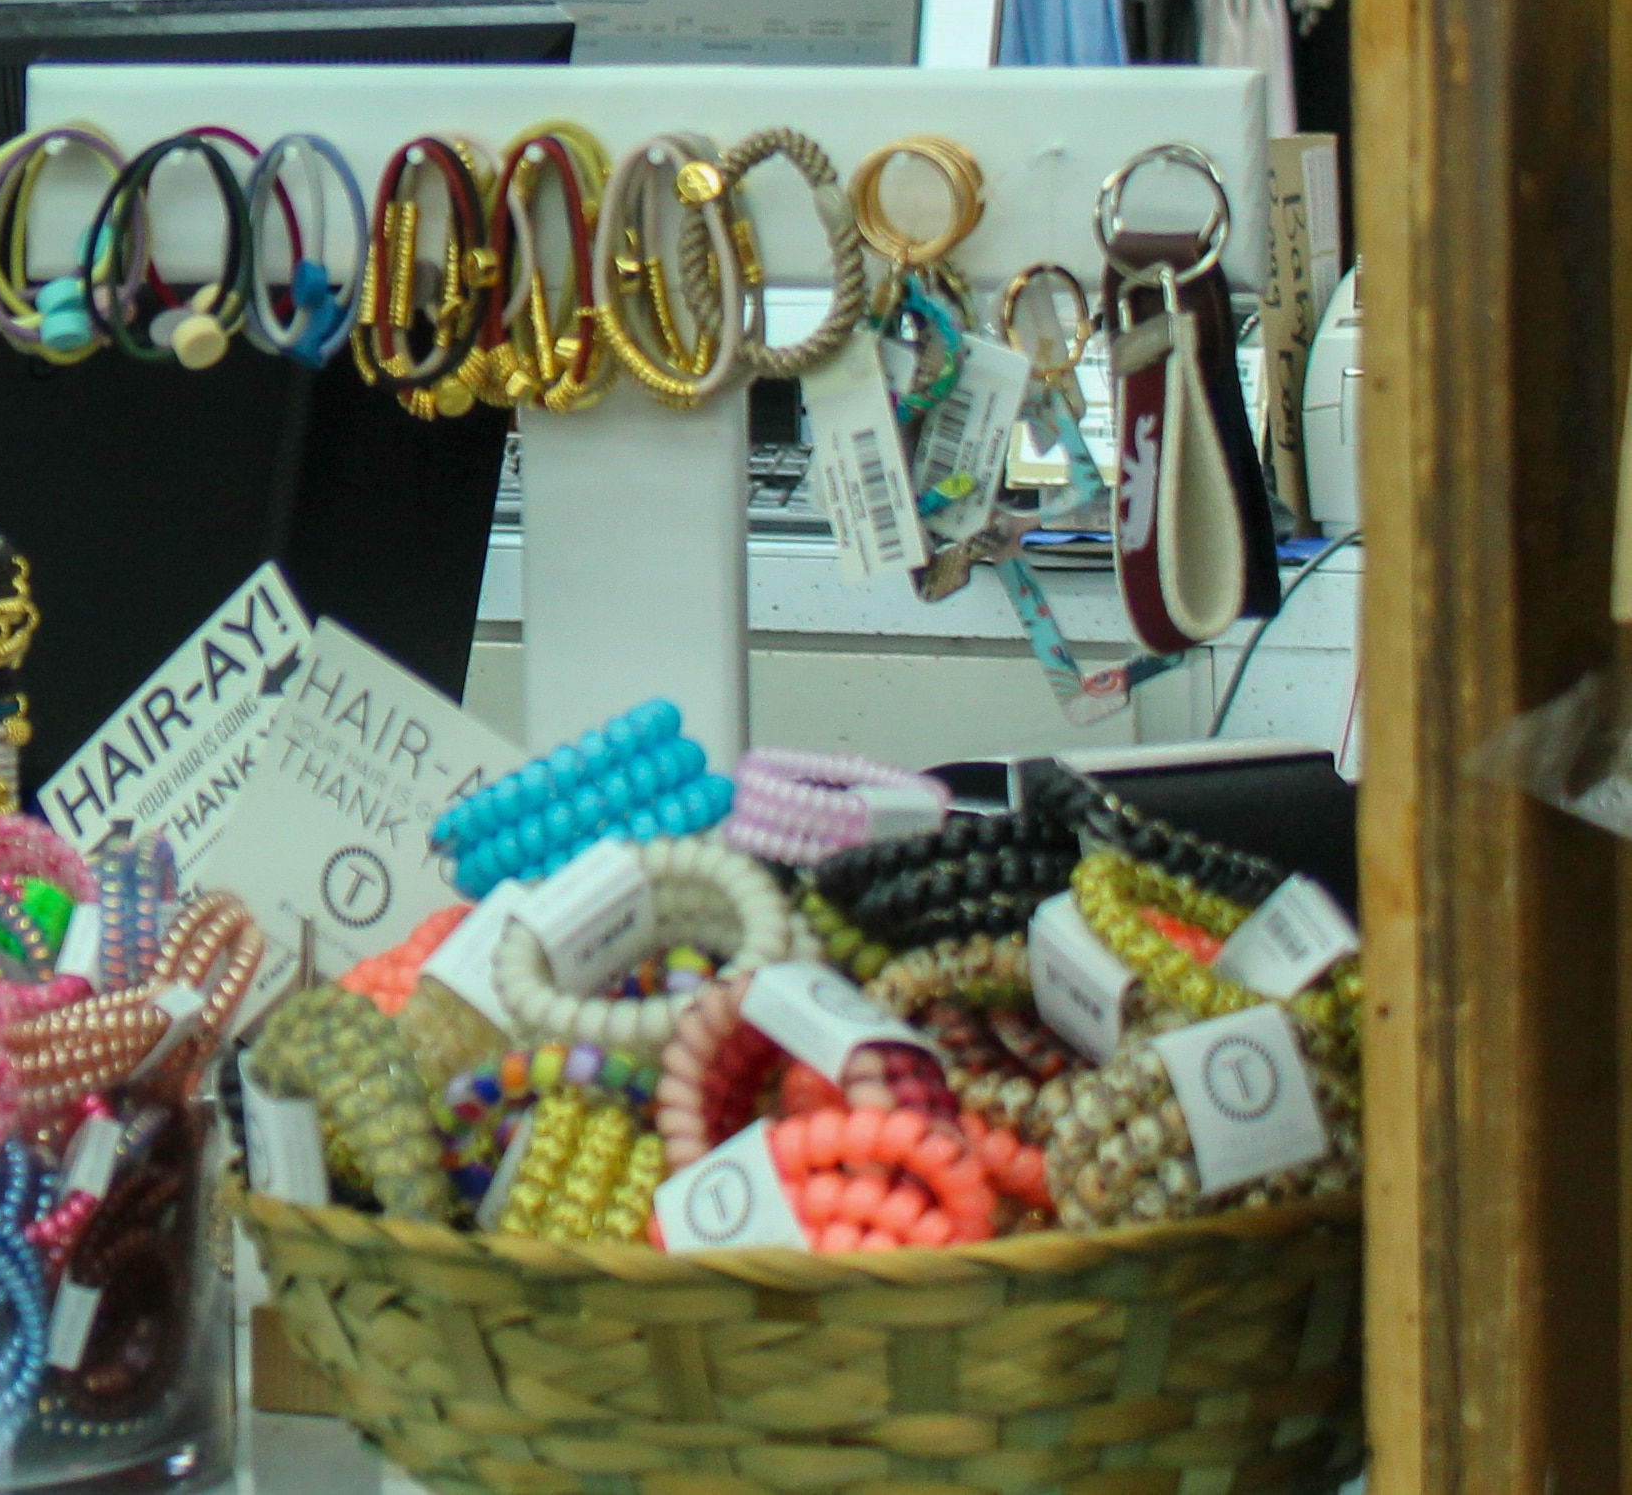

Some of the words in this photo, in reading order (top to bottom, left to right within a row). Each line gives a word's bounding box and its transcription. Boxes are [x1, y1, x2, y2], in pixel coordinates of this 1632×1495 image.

[52, 583, 288, 837] HAIR-AY!
[133, 773, 172, 823] YOUR
[171, 747, 203, 788] HAIR
[201, 732, 219, 755] IS
[218, 694, 260, 744] GOING
[279, 736, 409, 847] THANK
